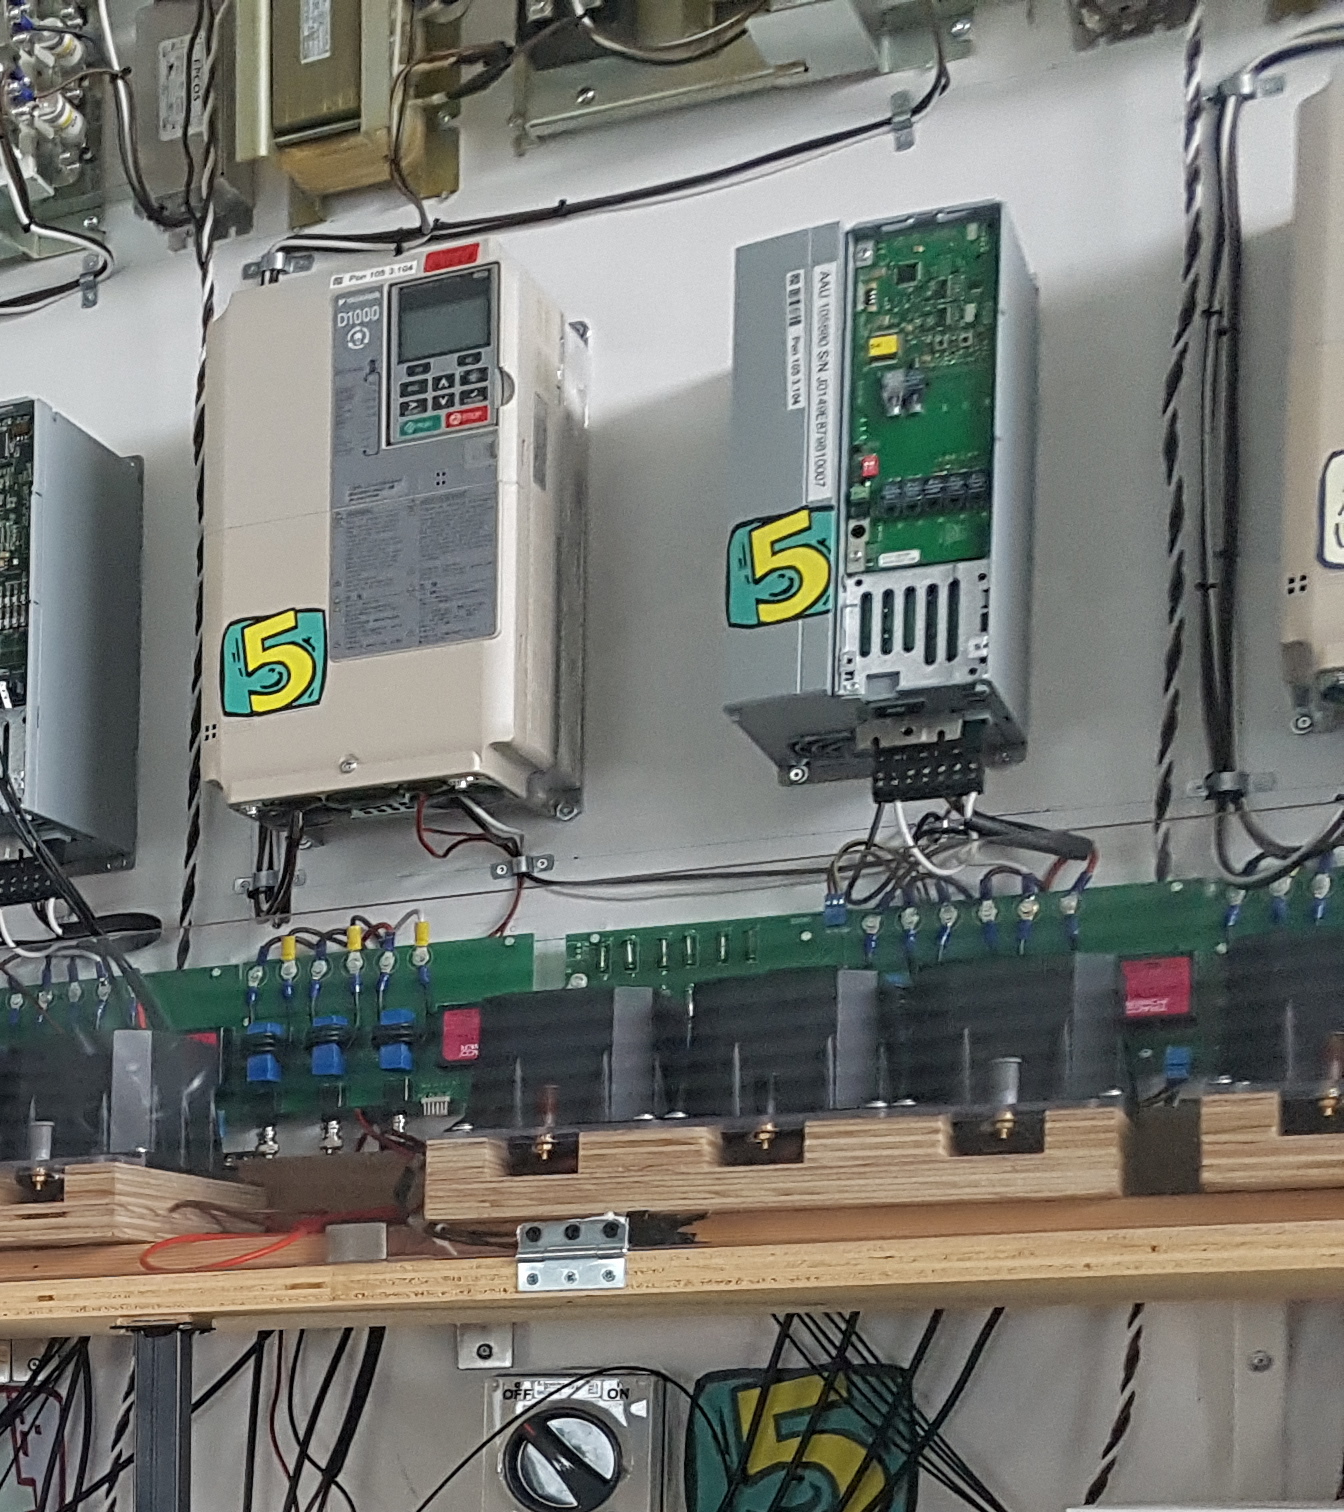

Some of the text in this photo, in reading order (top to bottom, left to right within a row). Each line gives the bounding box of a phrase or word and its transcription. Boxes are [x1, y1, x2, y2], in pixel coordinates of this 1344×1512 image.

[819, 270, 831, 298] AAU
[337, 305, 380, 328] D1000
[750, 508, 832, 624] 5
[243, 610, 317, 714] 5
[502, 1388, 534, 1400] OFF
[607, 1387, 630, 1400] ON
